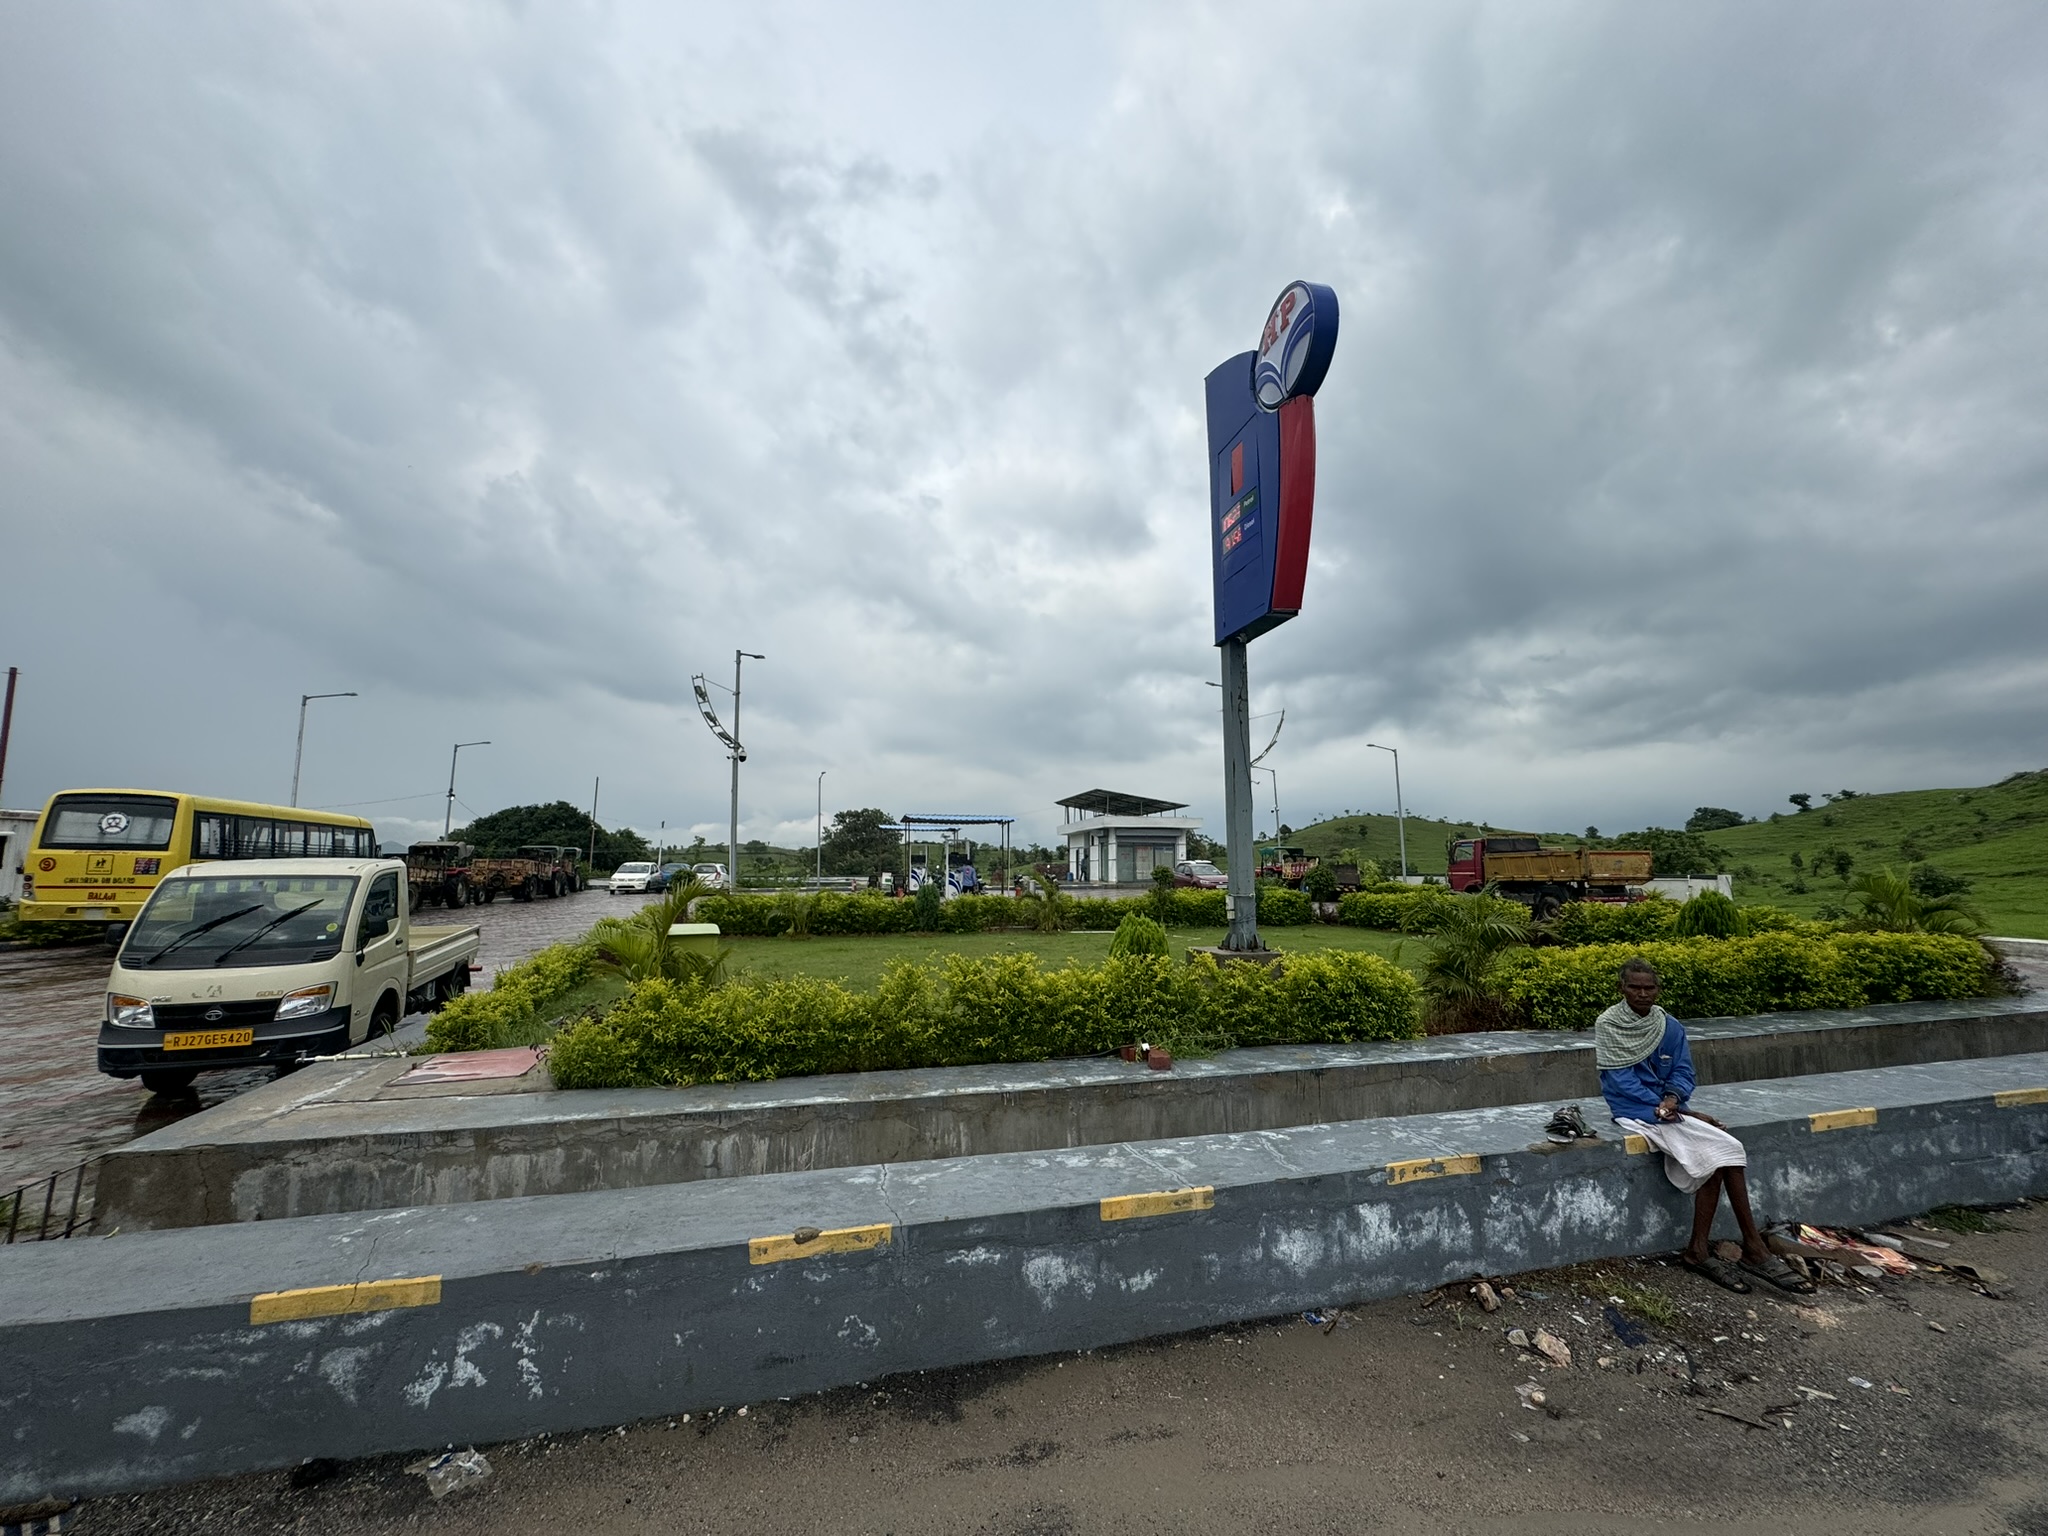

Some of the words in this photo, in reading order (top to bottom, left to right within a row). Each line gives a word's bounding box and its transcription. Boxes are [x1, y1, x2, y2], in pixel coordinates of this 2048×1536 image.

[1263, 291, 1296, 357] HP
[87, 892, 117, 901] BALAJI
[256, 989, 284, 998] GOLD
[172, 1032, 251, 1047] RJ27GE5420
